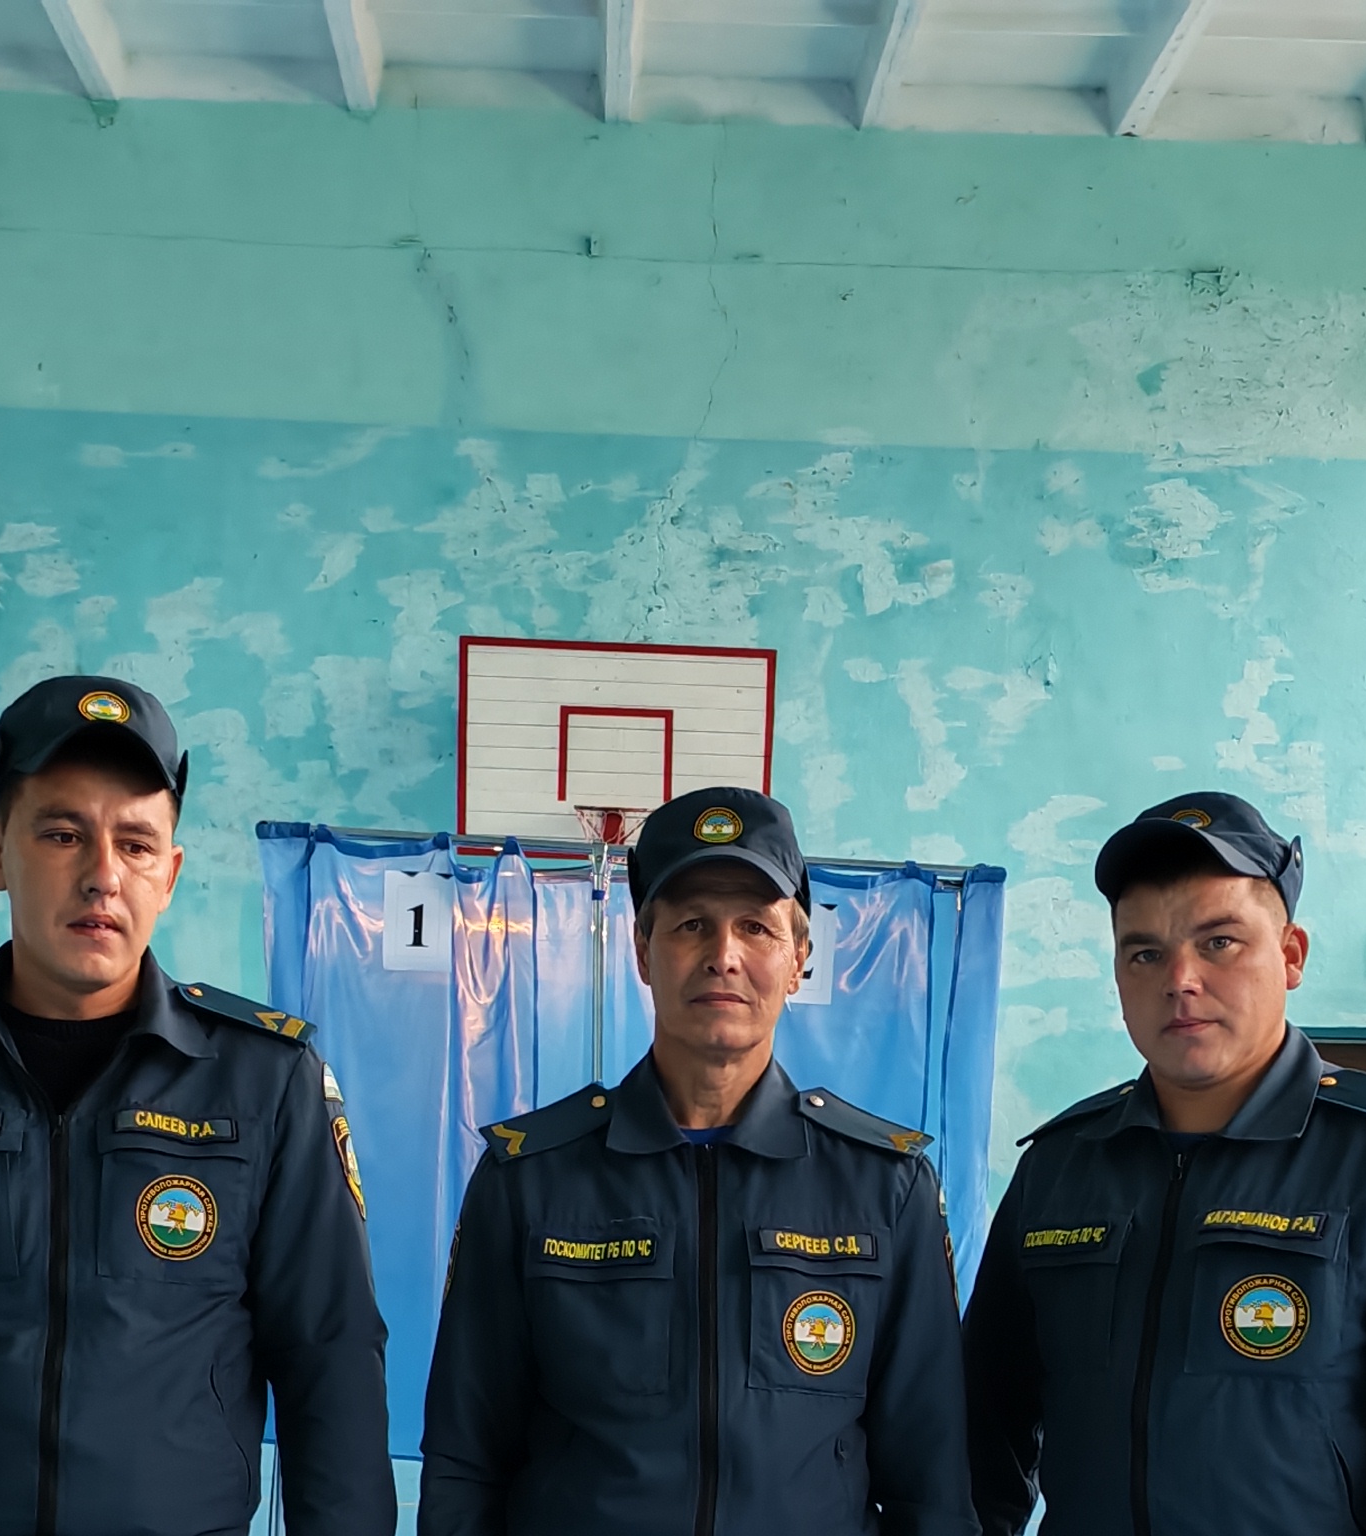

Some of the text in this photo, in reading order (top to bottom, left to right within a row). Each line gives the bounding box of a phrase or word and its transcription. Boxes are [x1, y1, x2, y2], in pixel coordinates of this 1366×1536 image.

[405, 903, 430, 948] 1
[135, 1111, 216, 1138] САЛЕЕВ Р.А.
[621, 1240, 636, 1257] ПО
[637, 1239, 652, 1256] ЧС
[775, 1231, 831, 1254] СЕРГЕЕВ
